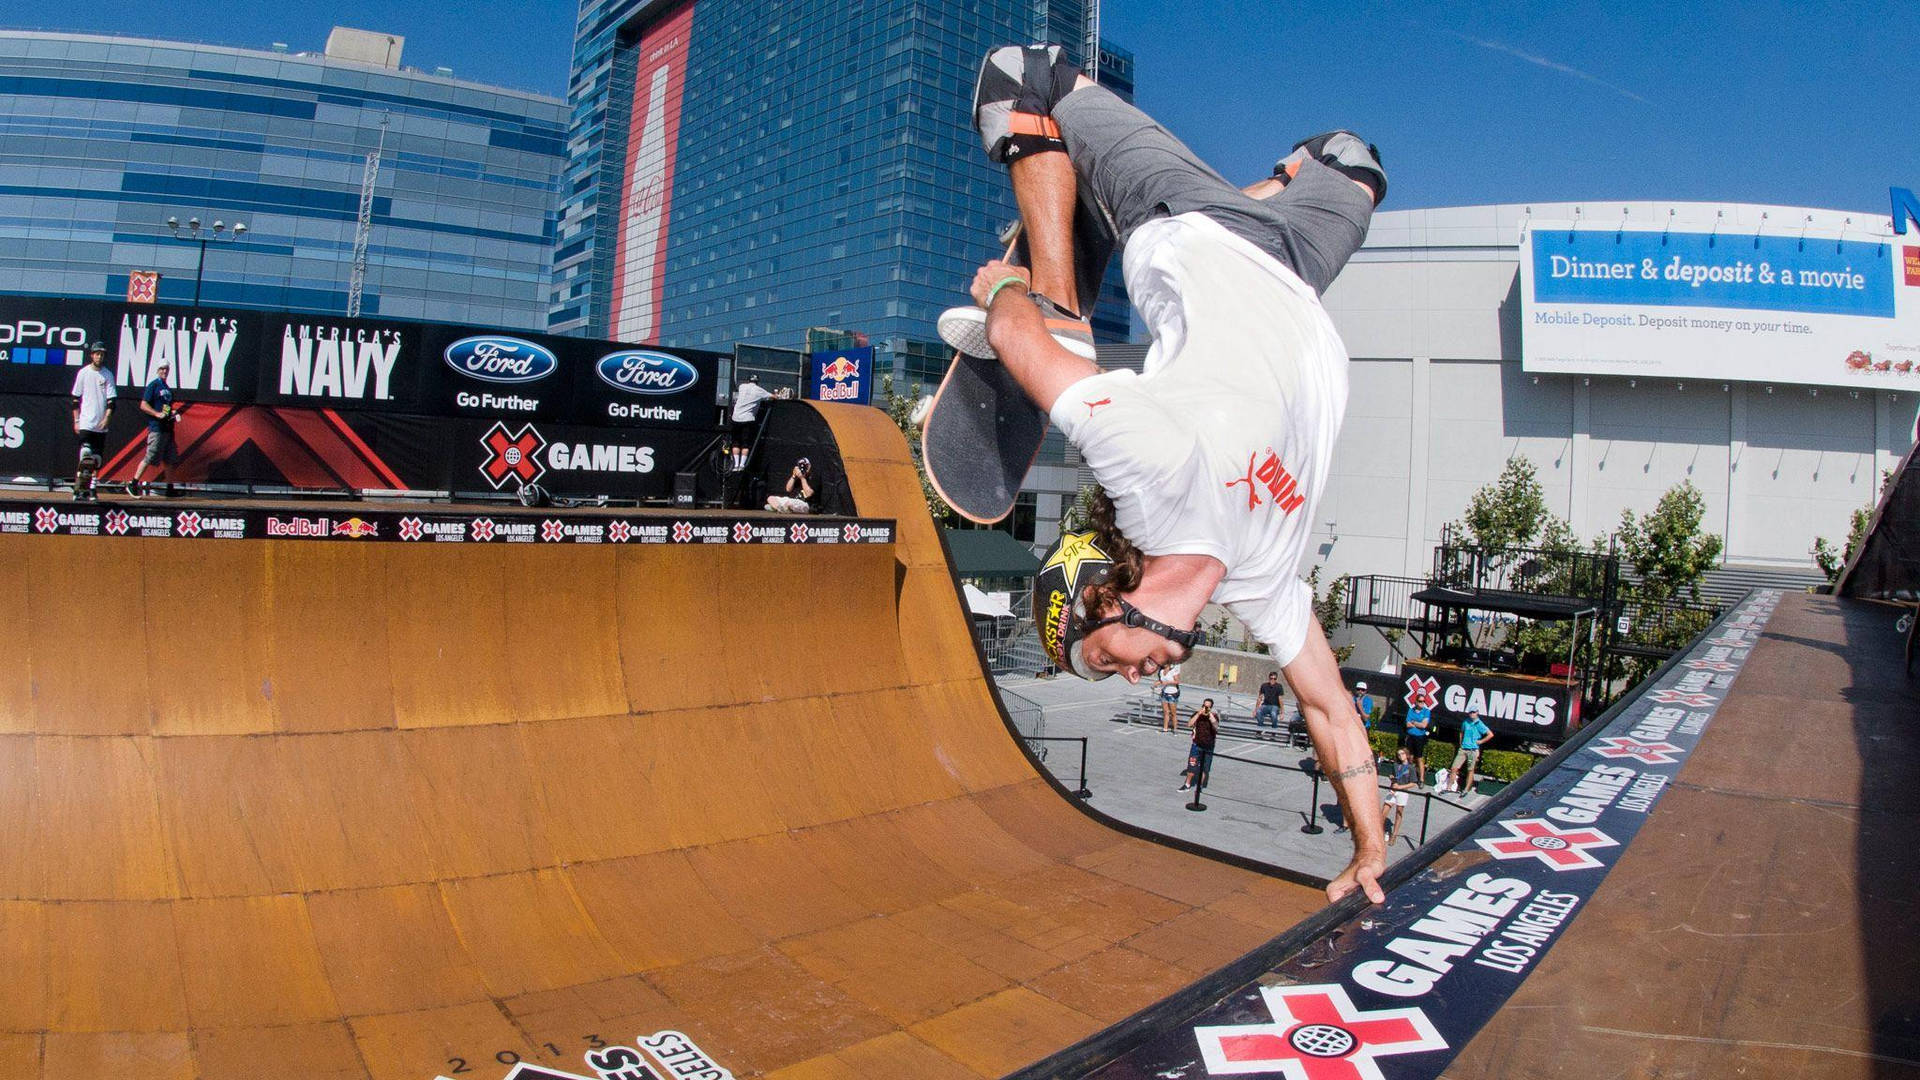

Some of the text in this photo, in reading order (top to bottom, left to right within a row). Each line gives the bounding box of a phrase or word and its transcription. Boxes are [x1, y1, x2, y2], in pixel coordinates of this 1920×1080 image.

[1551, 255, 1864, 289] Dinner & deposit & a movie
[1535, 312, 1813, 334] Mobile Deposit. Deposit money on your time.
[116, 327, 238, 391] NAVY
[466, 342, 535, 375] Ford
[280, 337, 401, 400] NAVY
[616, 356, 678, 387] Ford
[820, 381, 859, 400] Red Bull
[456, 392, 539, 411] Go Further
[608, 402, 682, 420] Go Further
[548, 442, 655, 473] GAMES
[58, 514, 100, 526] GAMES
[129, 516, 172, 528] GAMES
[201, 518, 245, 531] GAMES
[267, 517, 329, 536] Red Bull
[423, 523, 466, 534] GAMES
[495, 524, 536, 535] GAMES
[564, 525, 604, 536] GAMES
[630, 526, 668, 536] GAMES
[693, 527, 729, 536] GAMES
[752, 527, 786, 537] GAMES
[808, 528, 839, 537] GAMES
[860, 528, 889, 537] GAMES
[1057, 605, 1070, 637] DRINK
[1444, 684, 1557, 726] GAMES
[1629, 706, 1686, 741] GAMES
[1546, 764, 1636, 824] GAMES
[1352, 872, 1532, 997] GAMES
[1474, 889, 1580, 974] LOS ANGELES
